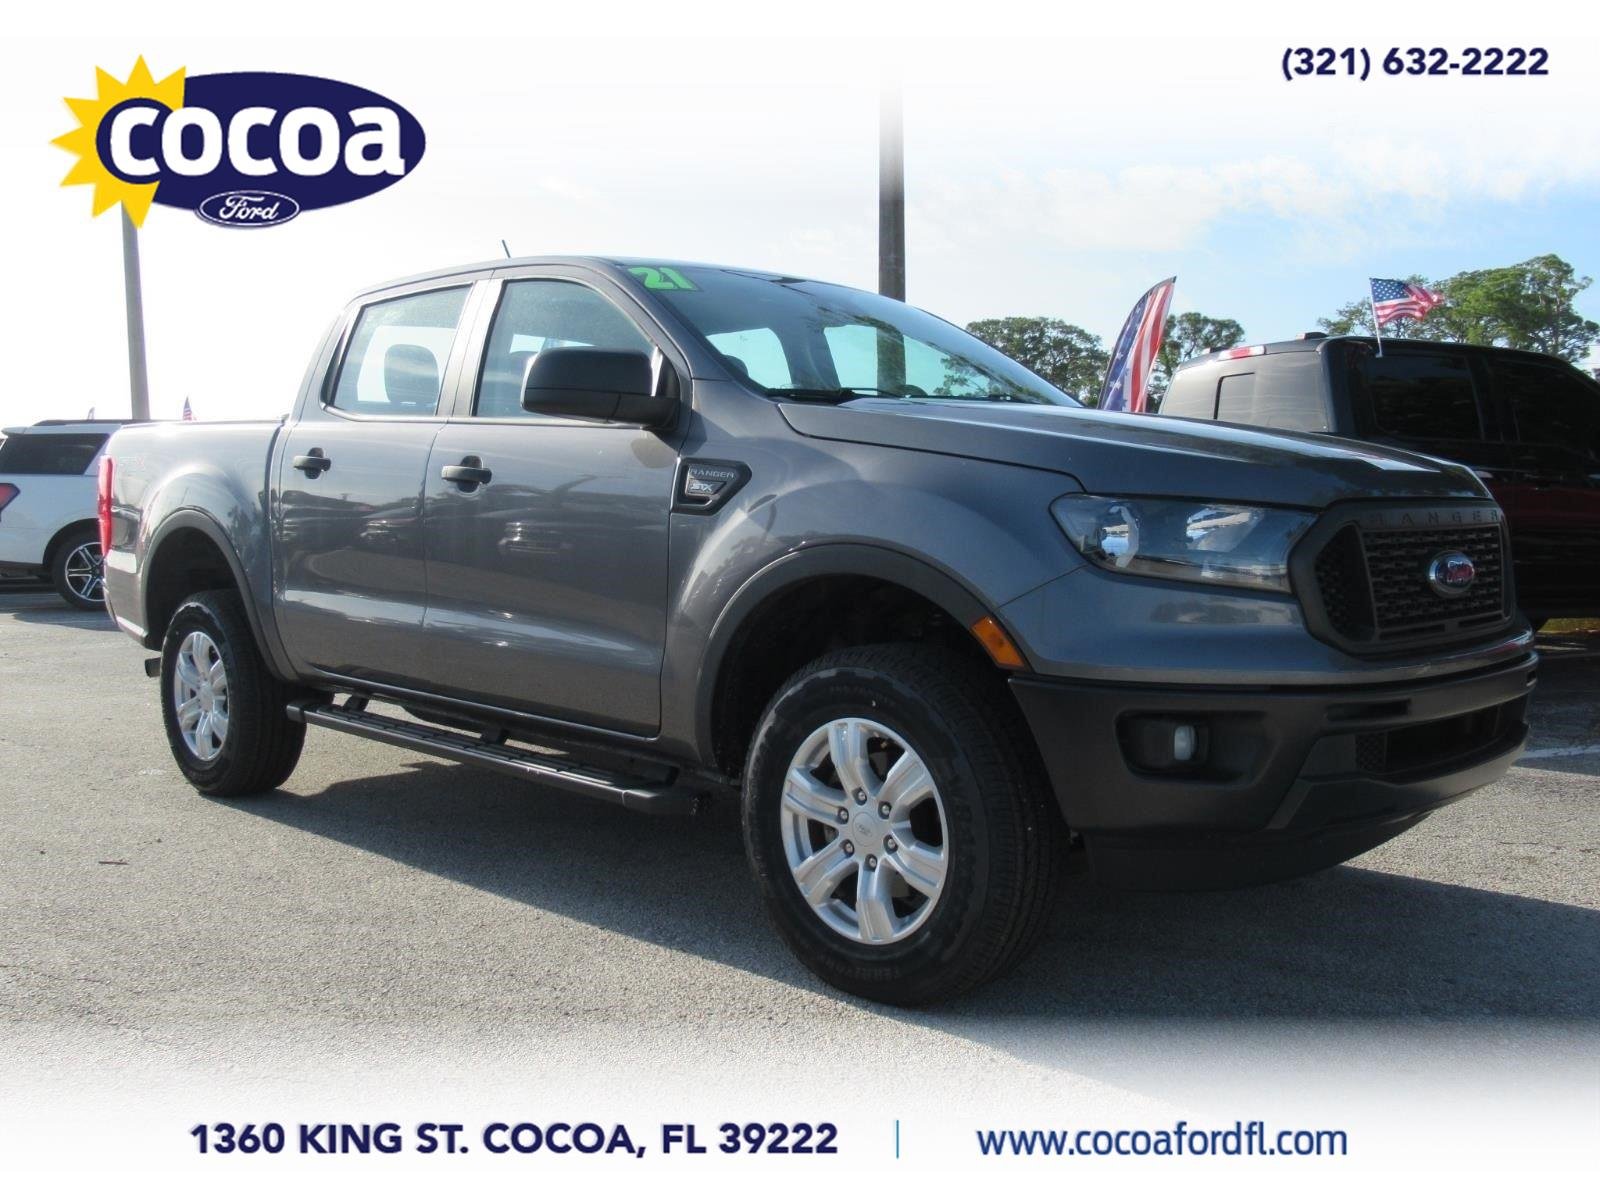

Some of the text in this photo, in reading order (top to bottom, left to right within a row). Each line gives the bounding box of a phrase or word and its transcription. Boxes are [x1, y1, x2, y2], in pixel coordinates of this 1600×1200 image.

[627, 266, 694, 290] 21
[690, 468, 735, 478] RANGER
[1369, 509, 1498, 528] RANGER
